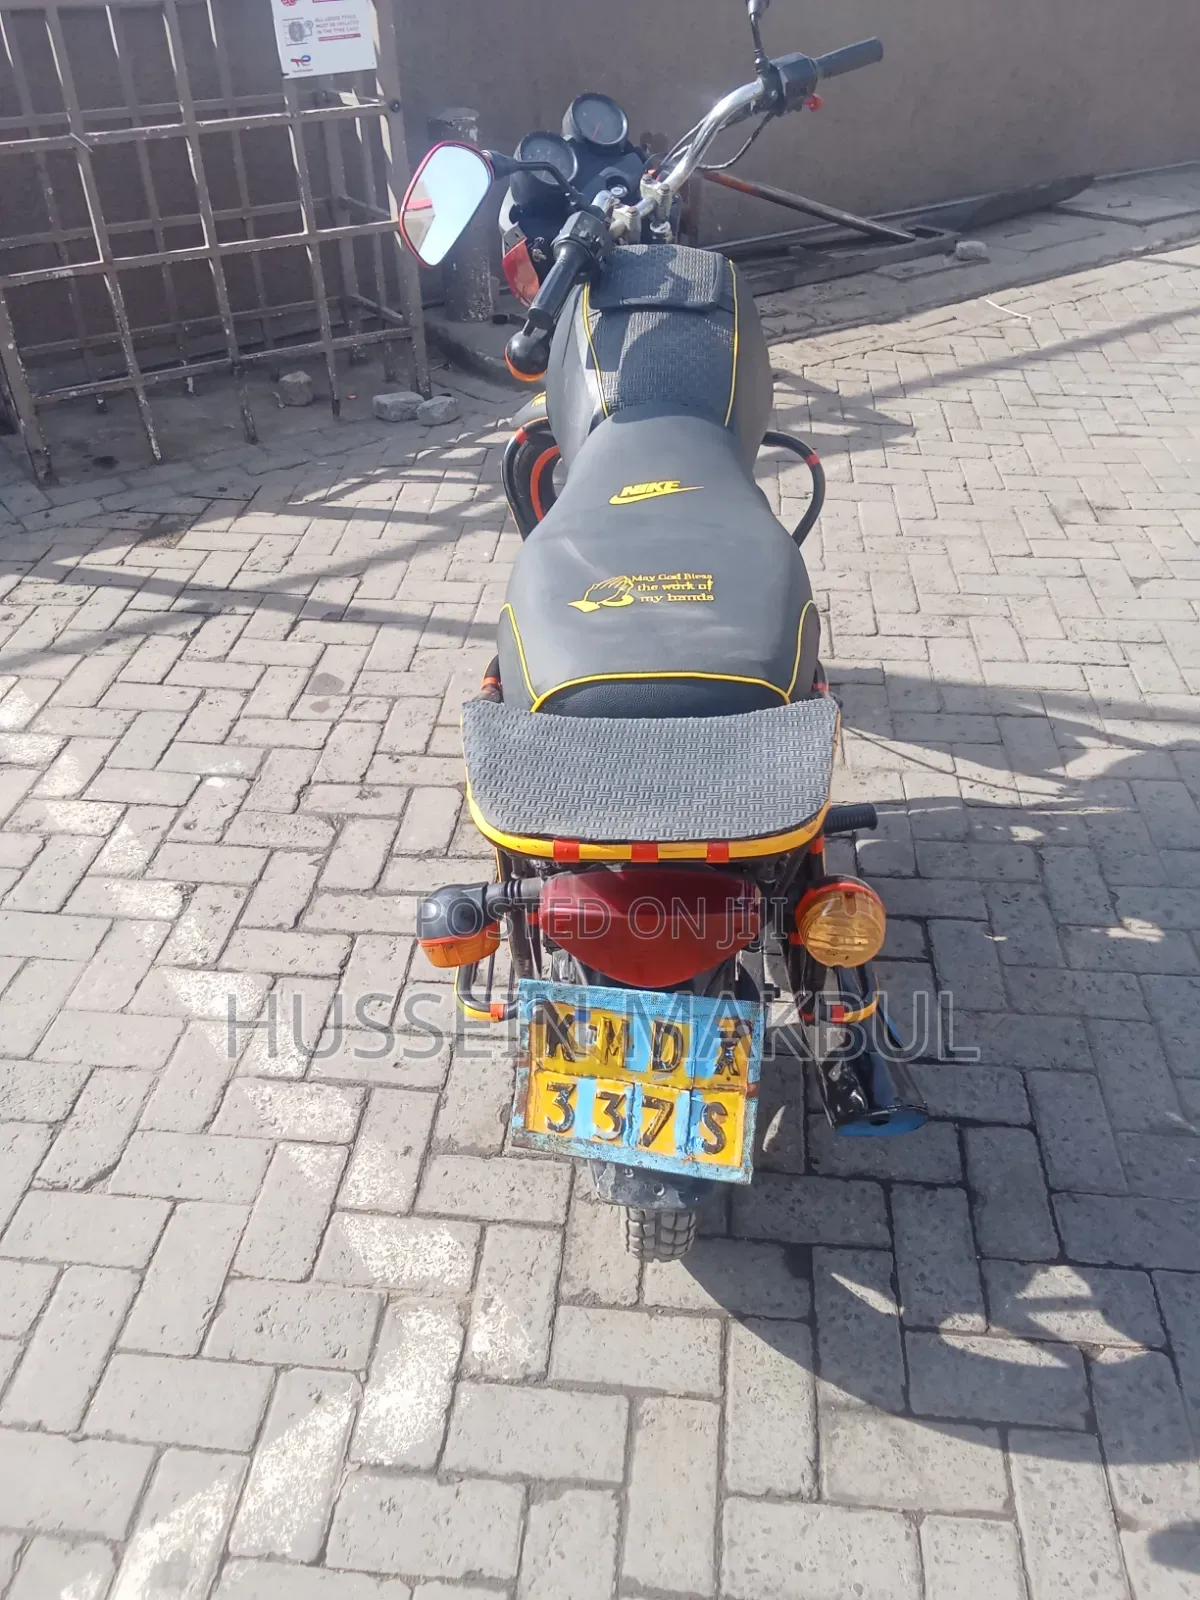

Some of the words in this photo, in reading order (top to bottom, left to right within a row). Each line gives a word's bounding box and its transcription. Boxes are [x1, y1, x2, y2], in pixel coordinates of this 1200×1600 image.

[619, 479, 681, 498] NIKE
[632, 574, 657, 583] May
[658, 572, 682, 581] God
[684, 572, 713, 580] Bless
[637, 582, 658, 592] the
[662, 581, 695, 591] work
[698, 580, 714, 592] of
[639, 594, 664, 604] my
[667, 592, 715, 602] hands
[545, 1082, 729, 1155] 337S
